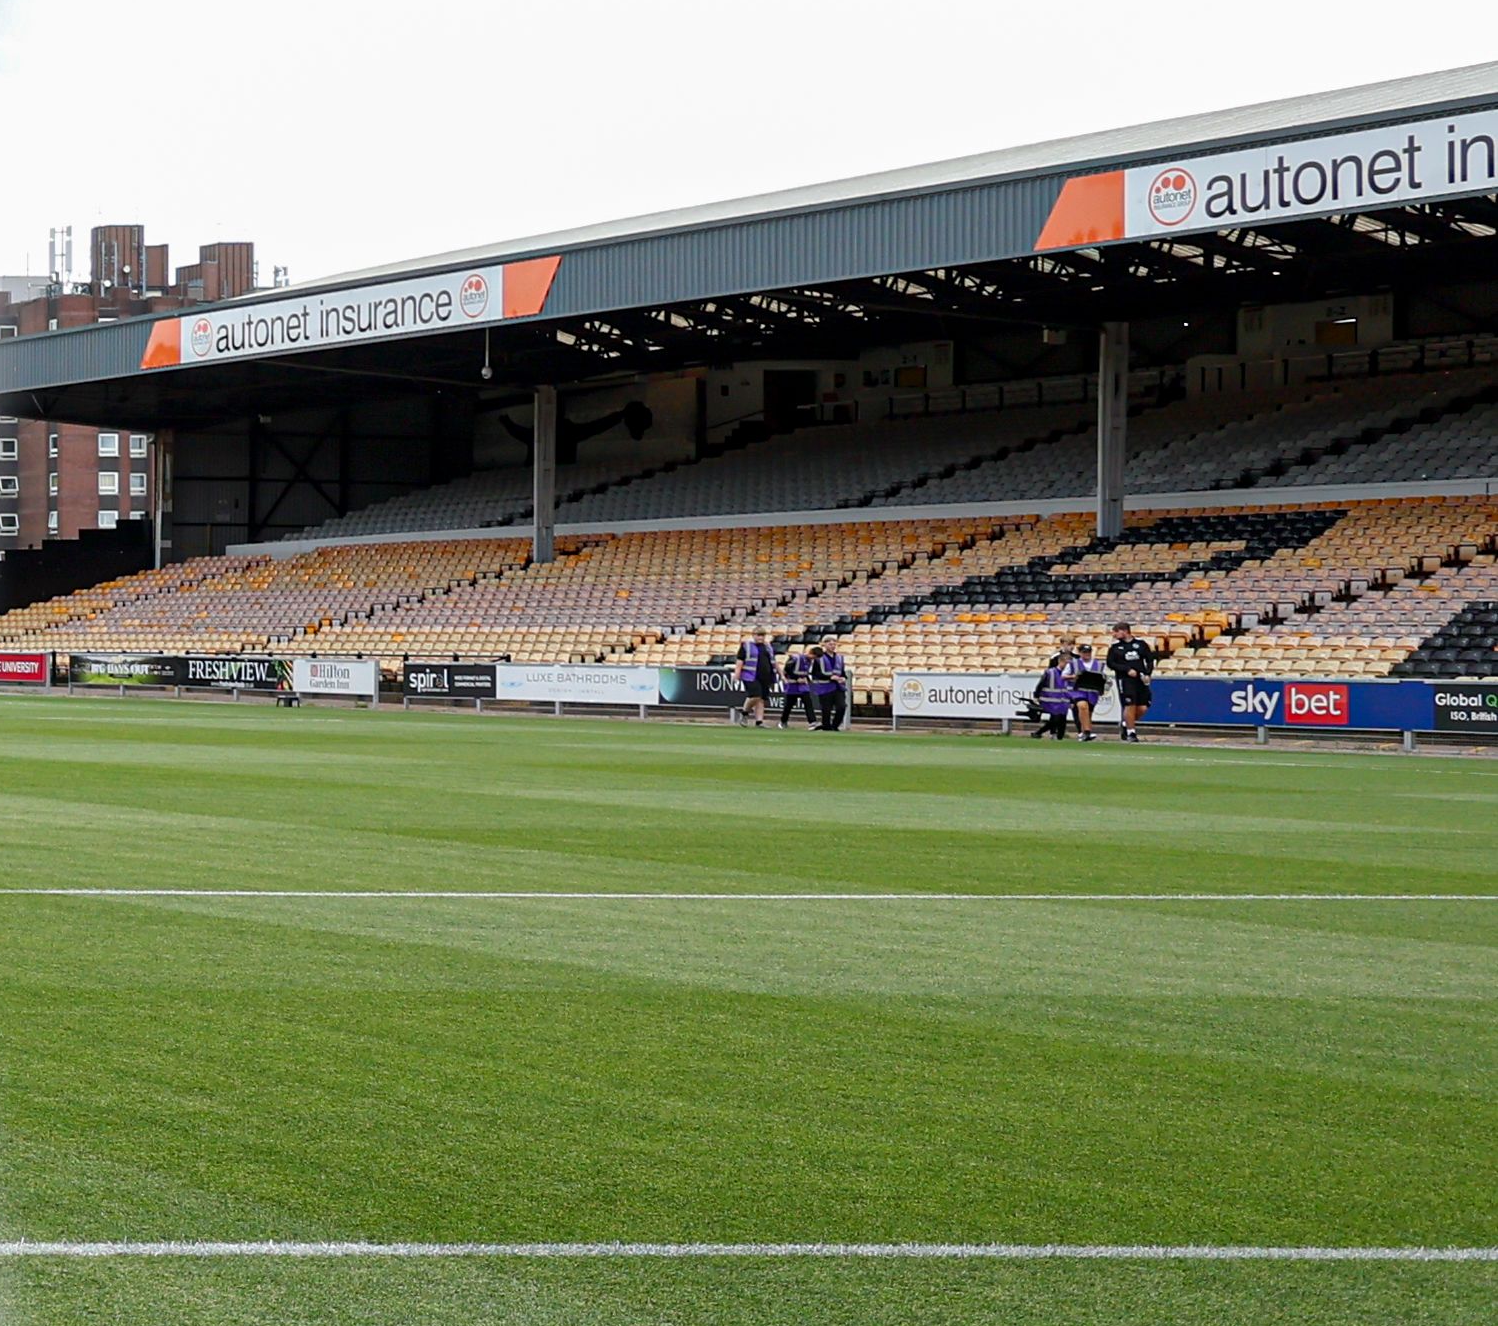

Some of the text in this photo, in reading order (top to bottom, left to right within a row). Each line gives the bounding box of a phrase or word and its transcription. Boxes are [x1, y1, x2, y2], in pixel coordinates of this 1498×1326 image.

[1205, 134, 1422, 218] autonet
[1153, 188, 1192, 205] autonet
[216, 289, 452, 352] autonet insurance
[2, 661, 39, 674] UNIVERSITY
[130, 664, 151, 675] OUT
[188, 660, 269, 681] FRESHVIEW
[319, 663, 350, 679] Hilton
[310, 679, 350, 689] Garden Inn
[526, 673, 627, 685] LUXE BATHROOMS
[928, 685, 993, 705] autonet
[1231, 684, 1341, 721] sky bet
[1435, 693, 1482, 707] Global
[1471, 711, 1497, 722] British
